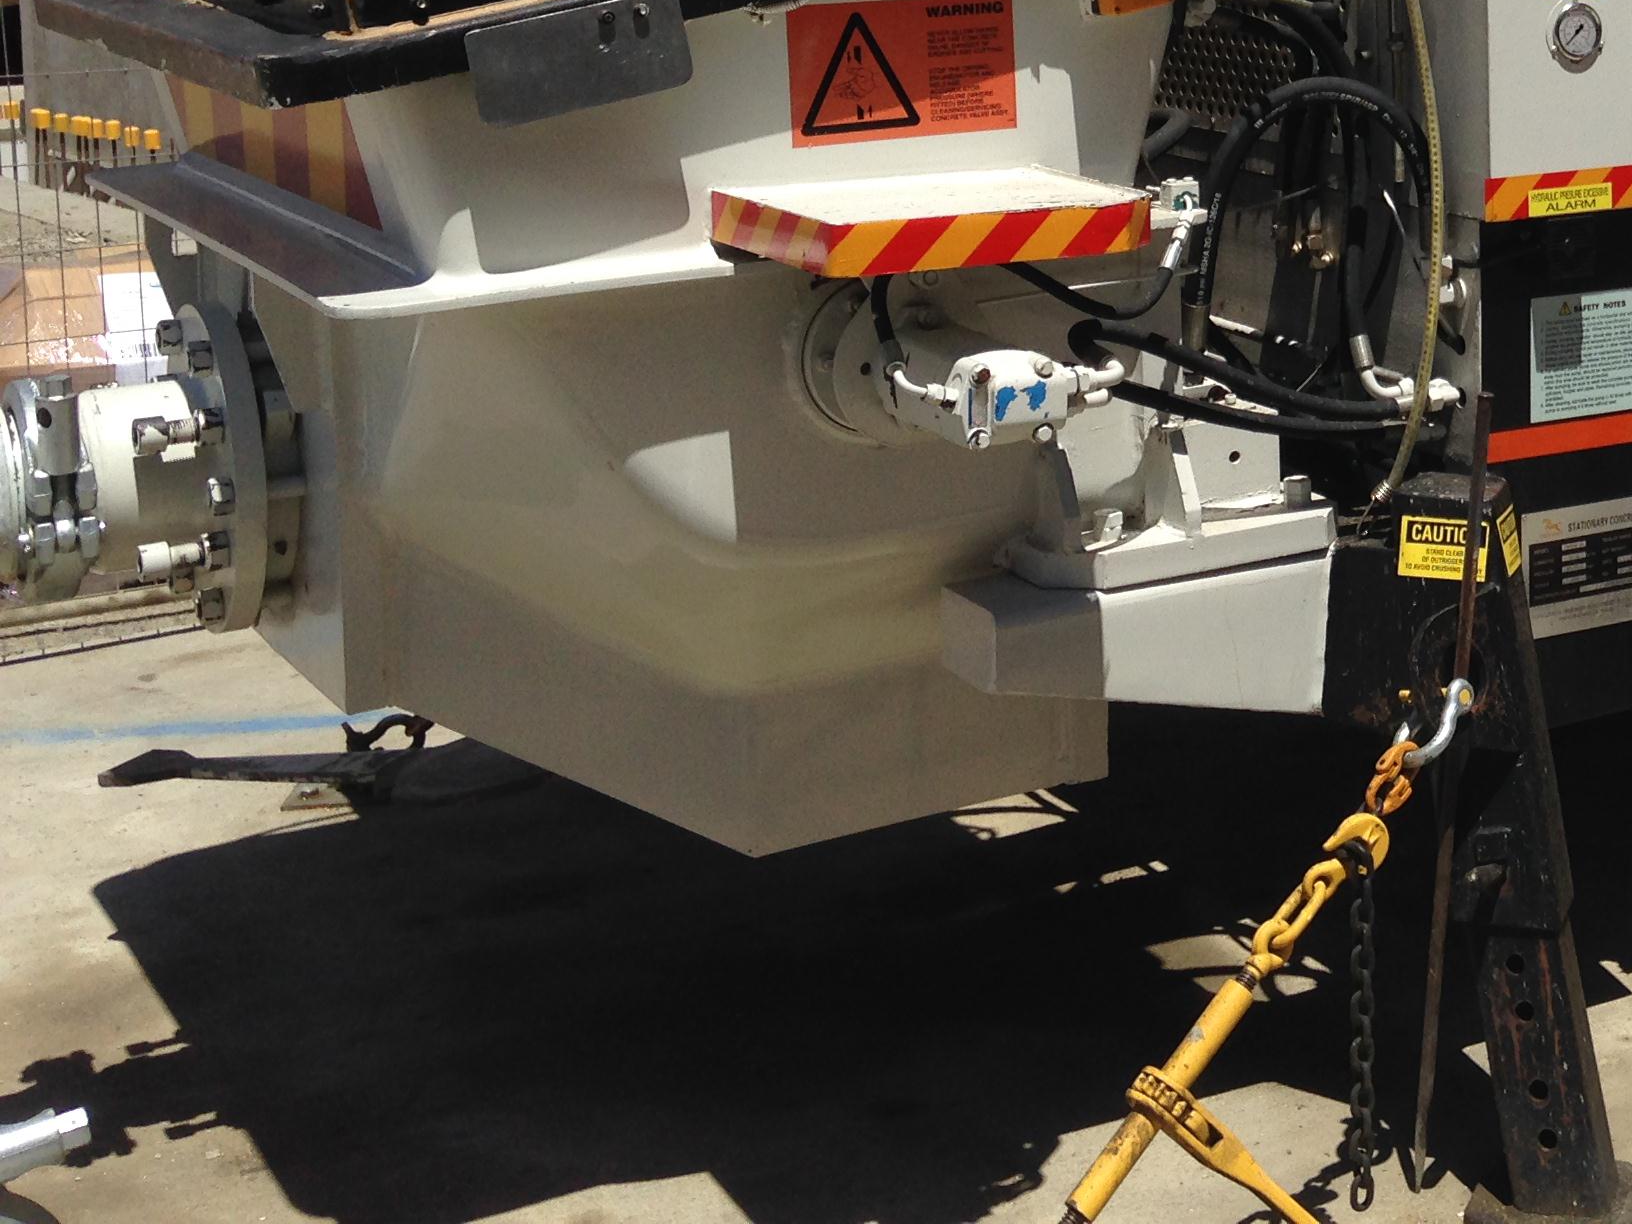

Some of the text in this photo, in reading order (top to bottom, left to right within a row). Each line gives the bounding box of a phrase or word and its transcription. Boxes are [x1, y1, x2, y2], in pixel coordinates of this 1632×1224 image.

[925, 1, 1004, 18] WARNING
[1545, 199, 1597, 213] ALARM
[1573, 300, 1627, 313] SAFETY NOTES
[1567, 518, 1609, 533] STATIONARY
[1411, 523, 1468, 545] CAUTIO
[1421, 555, 1430, 563] OF
[1425, 548, 1464, 557] STAND CLEAR
[1405, 562, 1413, 570] TO
